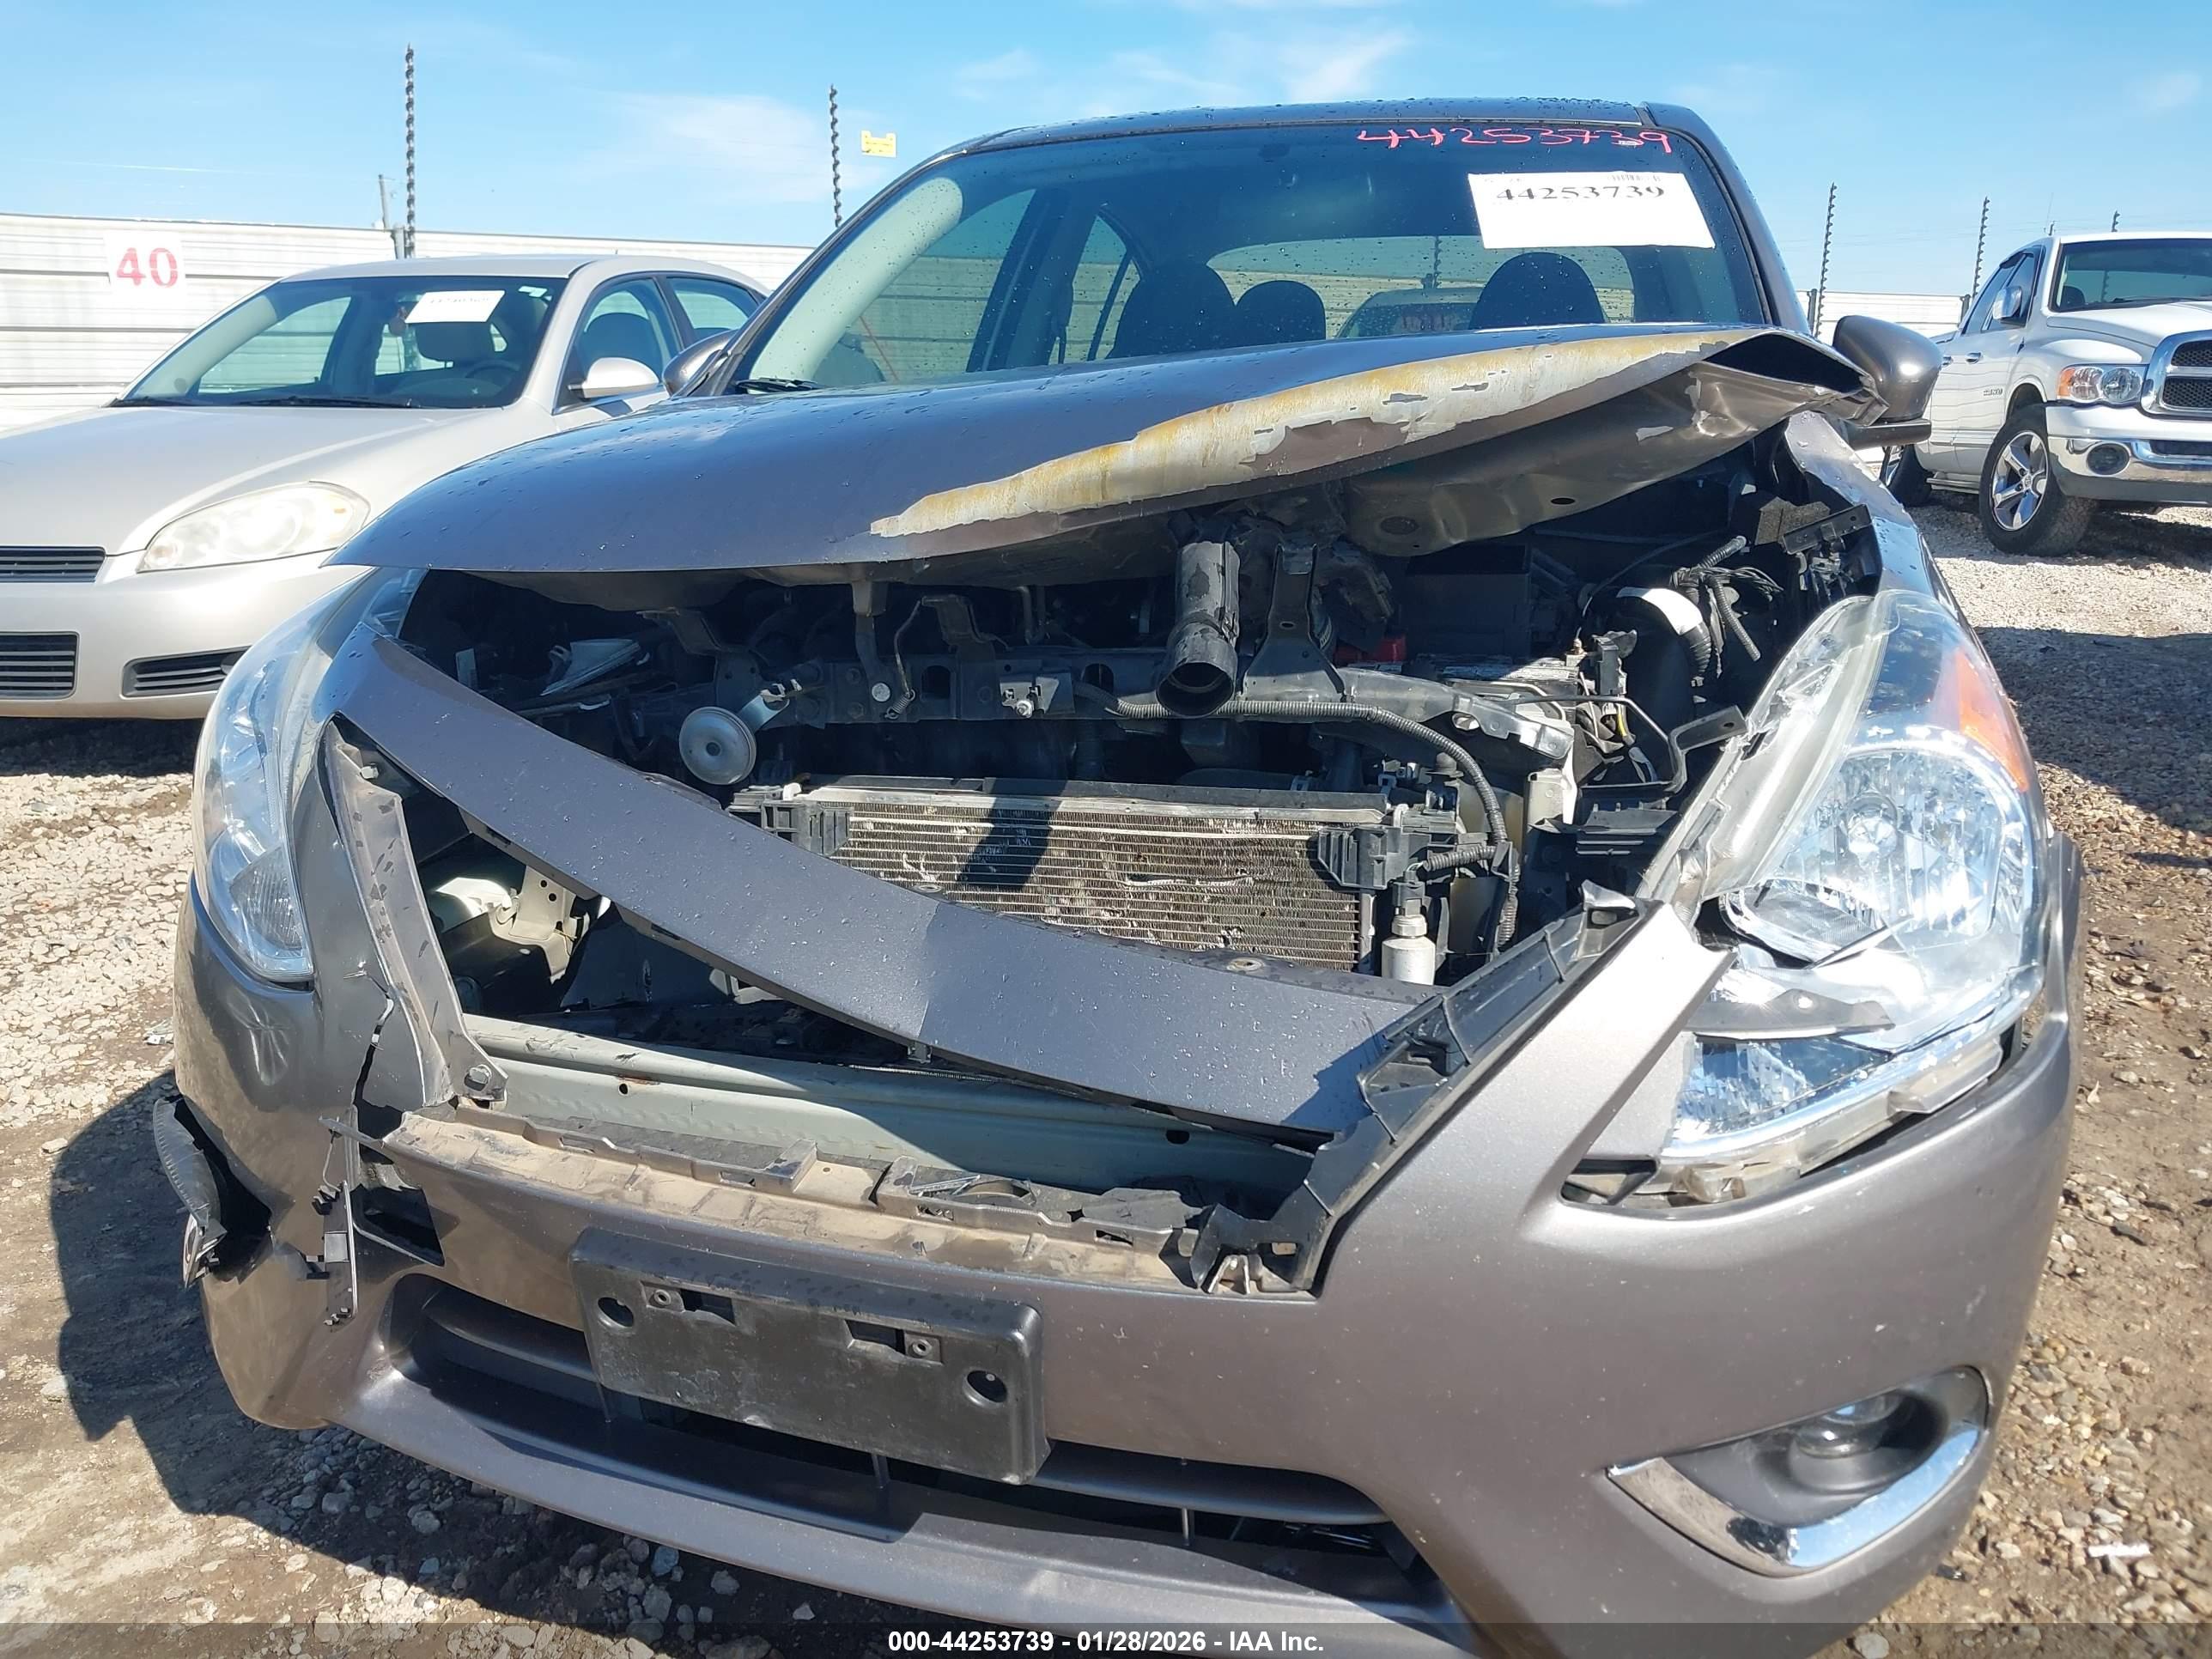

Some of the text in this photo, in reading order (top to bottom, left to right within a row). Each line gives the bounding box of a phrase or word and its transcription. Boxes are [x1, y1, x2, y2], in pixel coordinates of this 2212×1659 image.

[1357, 127, 1672, 154] 44253739
[1497, 185, 1665, 200] 44253739
[117, 246, 179, 289] 40
